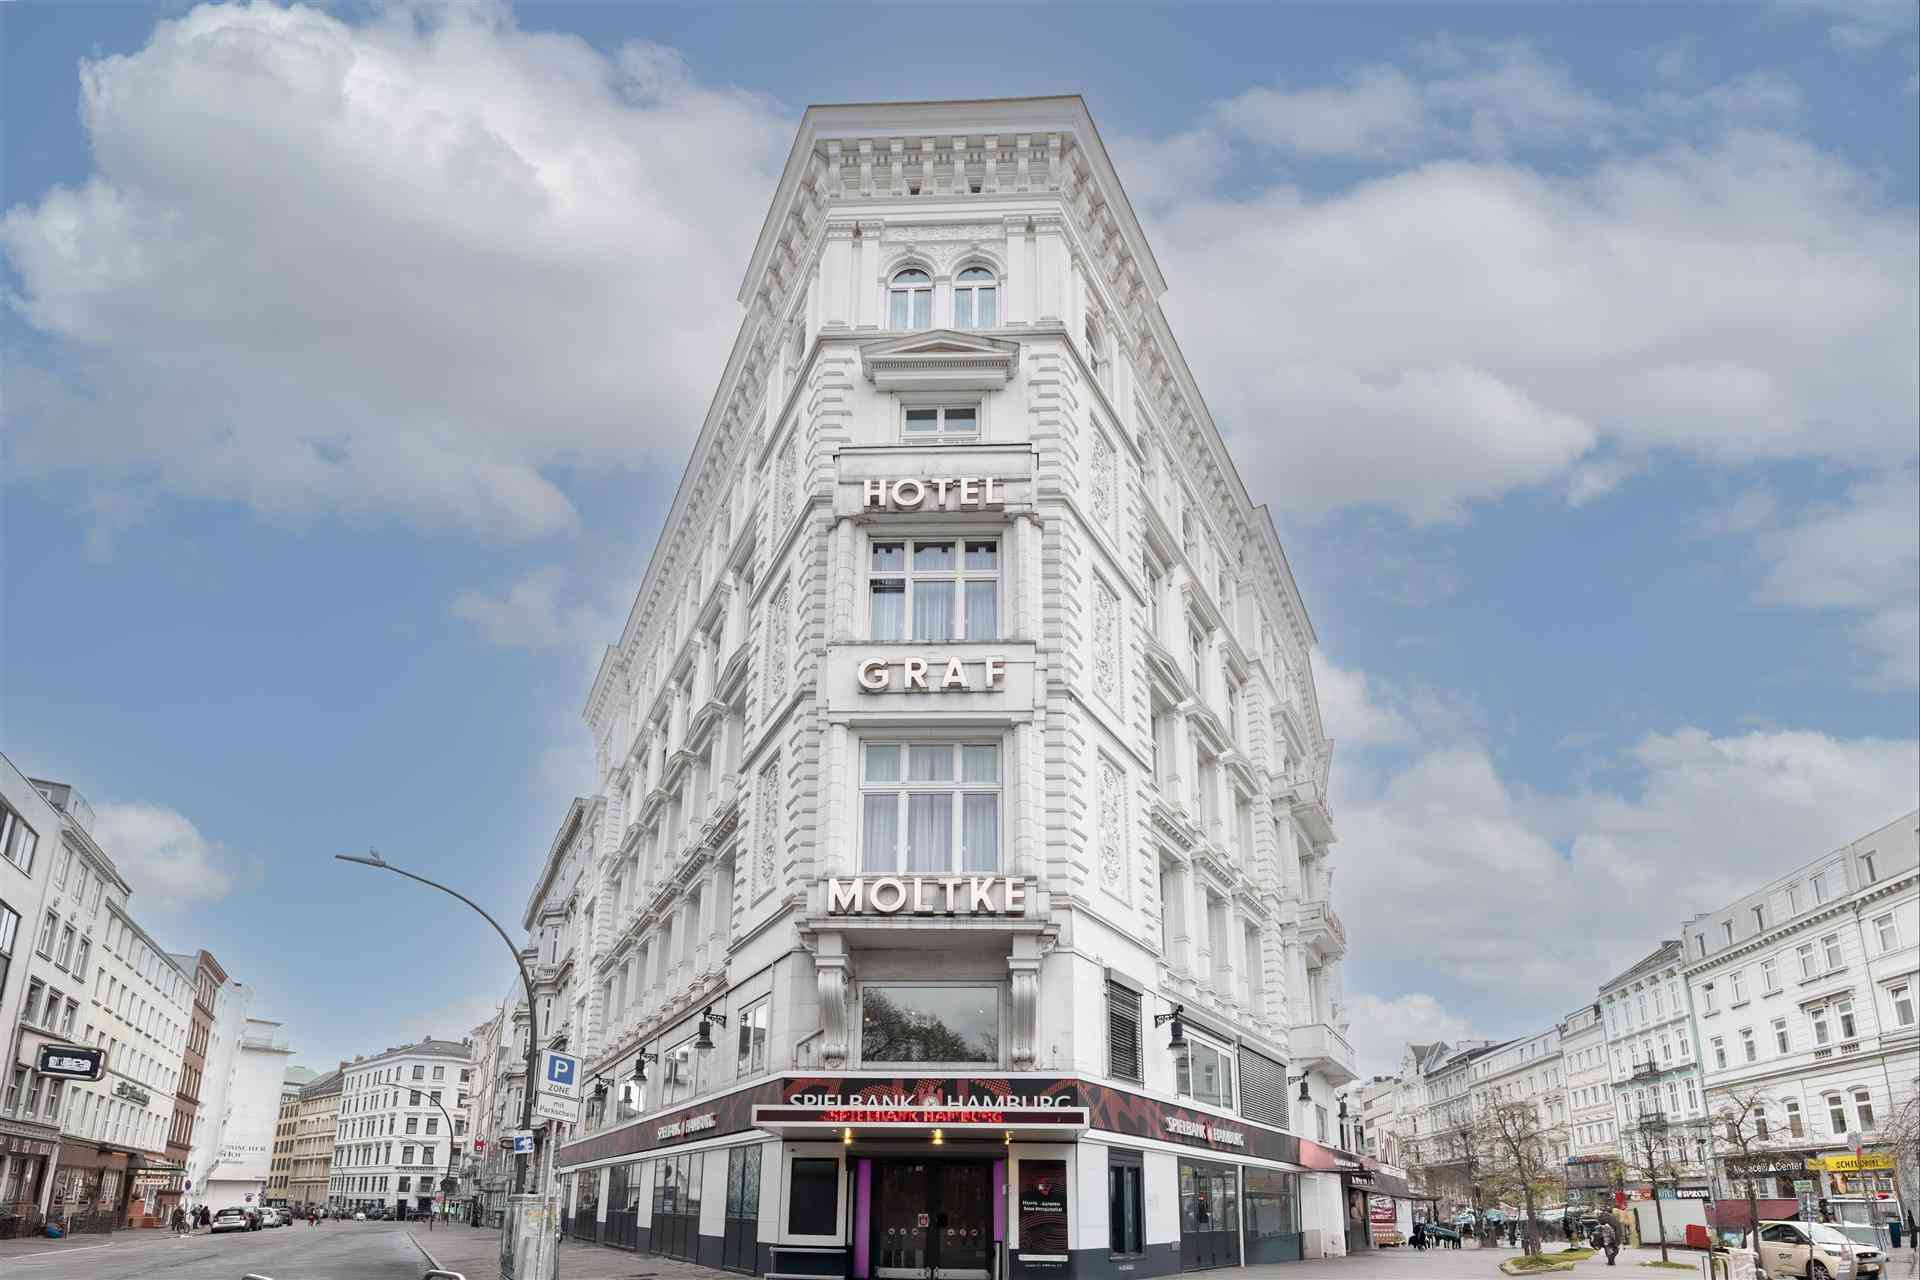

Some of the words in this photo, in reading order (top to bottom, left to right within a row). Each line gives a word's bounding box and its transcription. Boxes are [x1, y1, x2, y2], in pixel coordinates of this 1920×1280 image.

[863, 477, 1005, 508] HOTEL
[858, 655, 1007, 690] GRAF
[828, 877, 1025, 915] MOLTKE
[554, 1059, 568, 1079] P
[549, 1083, 570, 1096] ZONE
[789, 1093, 917, 1107] SPIELBANK
[946, 1095, 1072, 1108] HAMBURG
[1775, 1161, 1803, 1171] Center
